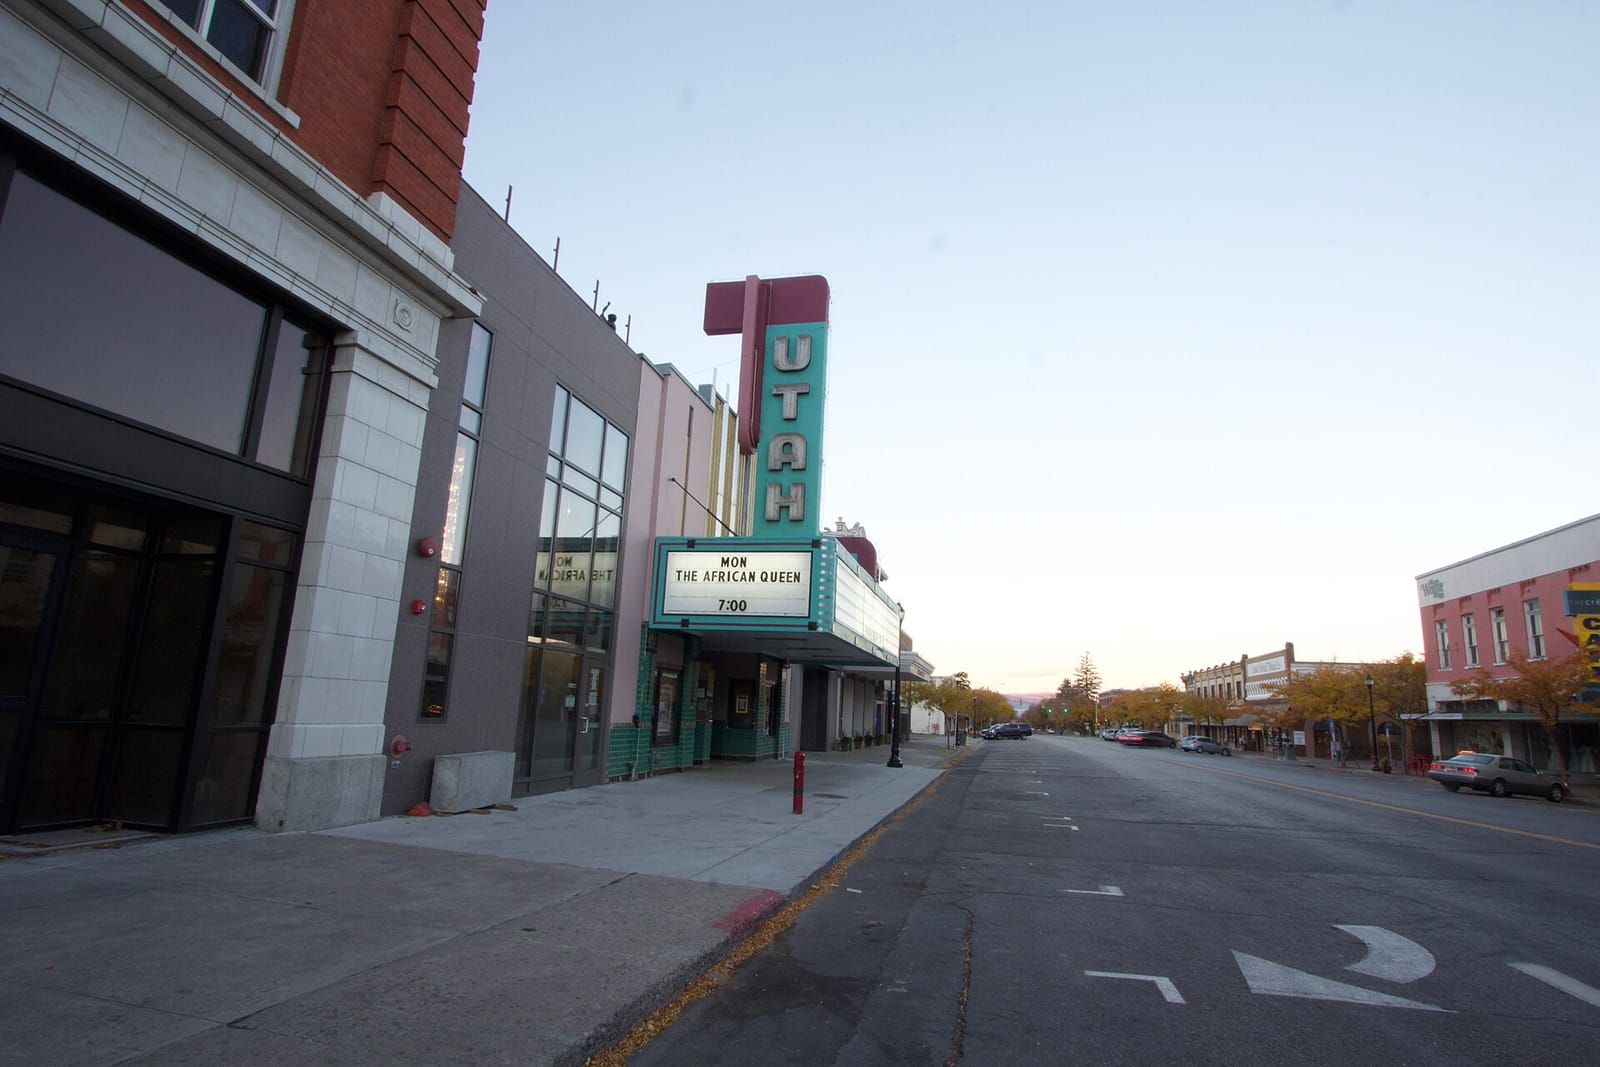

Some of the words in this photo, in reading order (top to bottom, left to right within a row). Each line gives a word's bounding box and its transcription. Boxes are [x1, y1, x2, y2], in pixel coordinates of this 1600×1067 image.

[765, 334, 812, 521] UTAH
[720, 556, 747, 568] MON
[675, 569, 698, 582] THE
[703, 570, 755, 583] AFRICAN
[760, 571, 801, 583] QUEEN
[718, 599, 747, 612] 7:00
